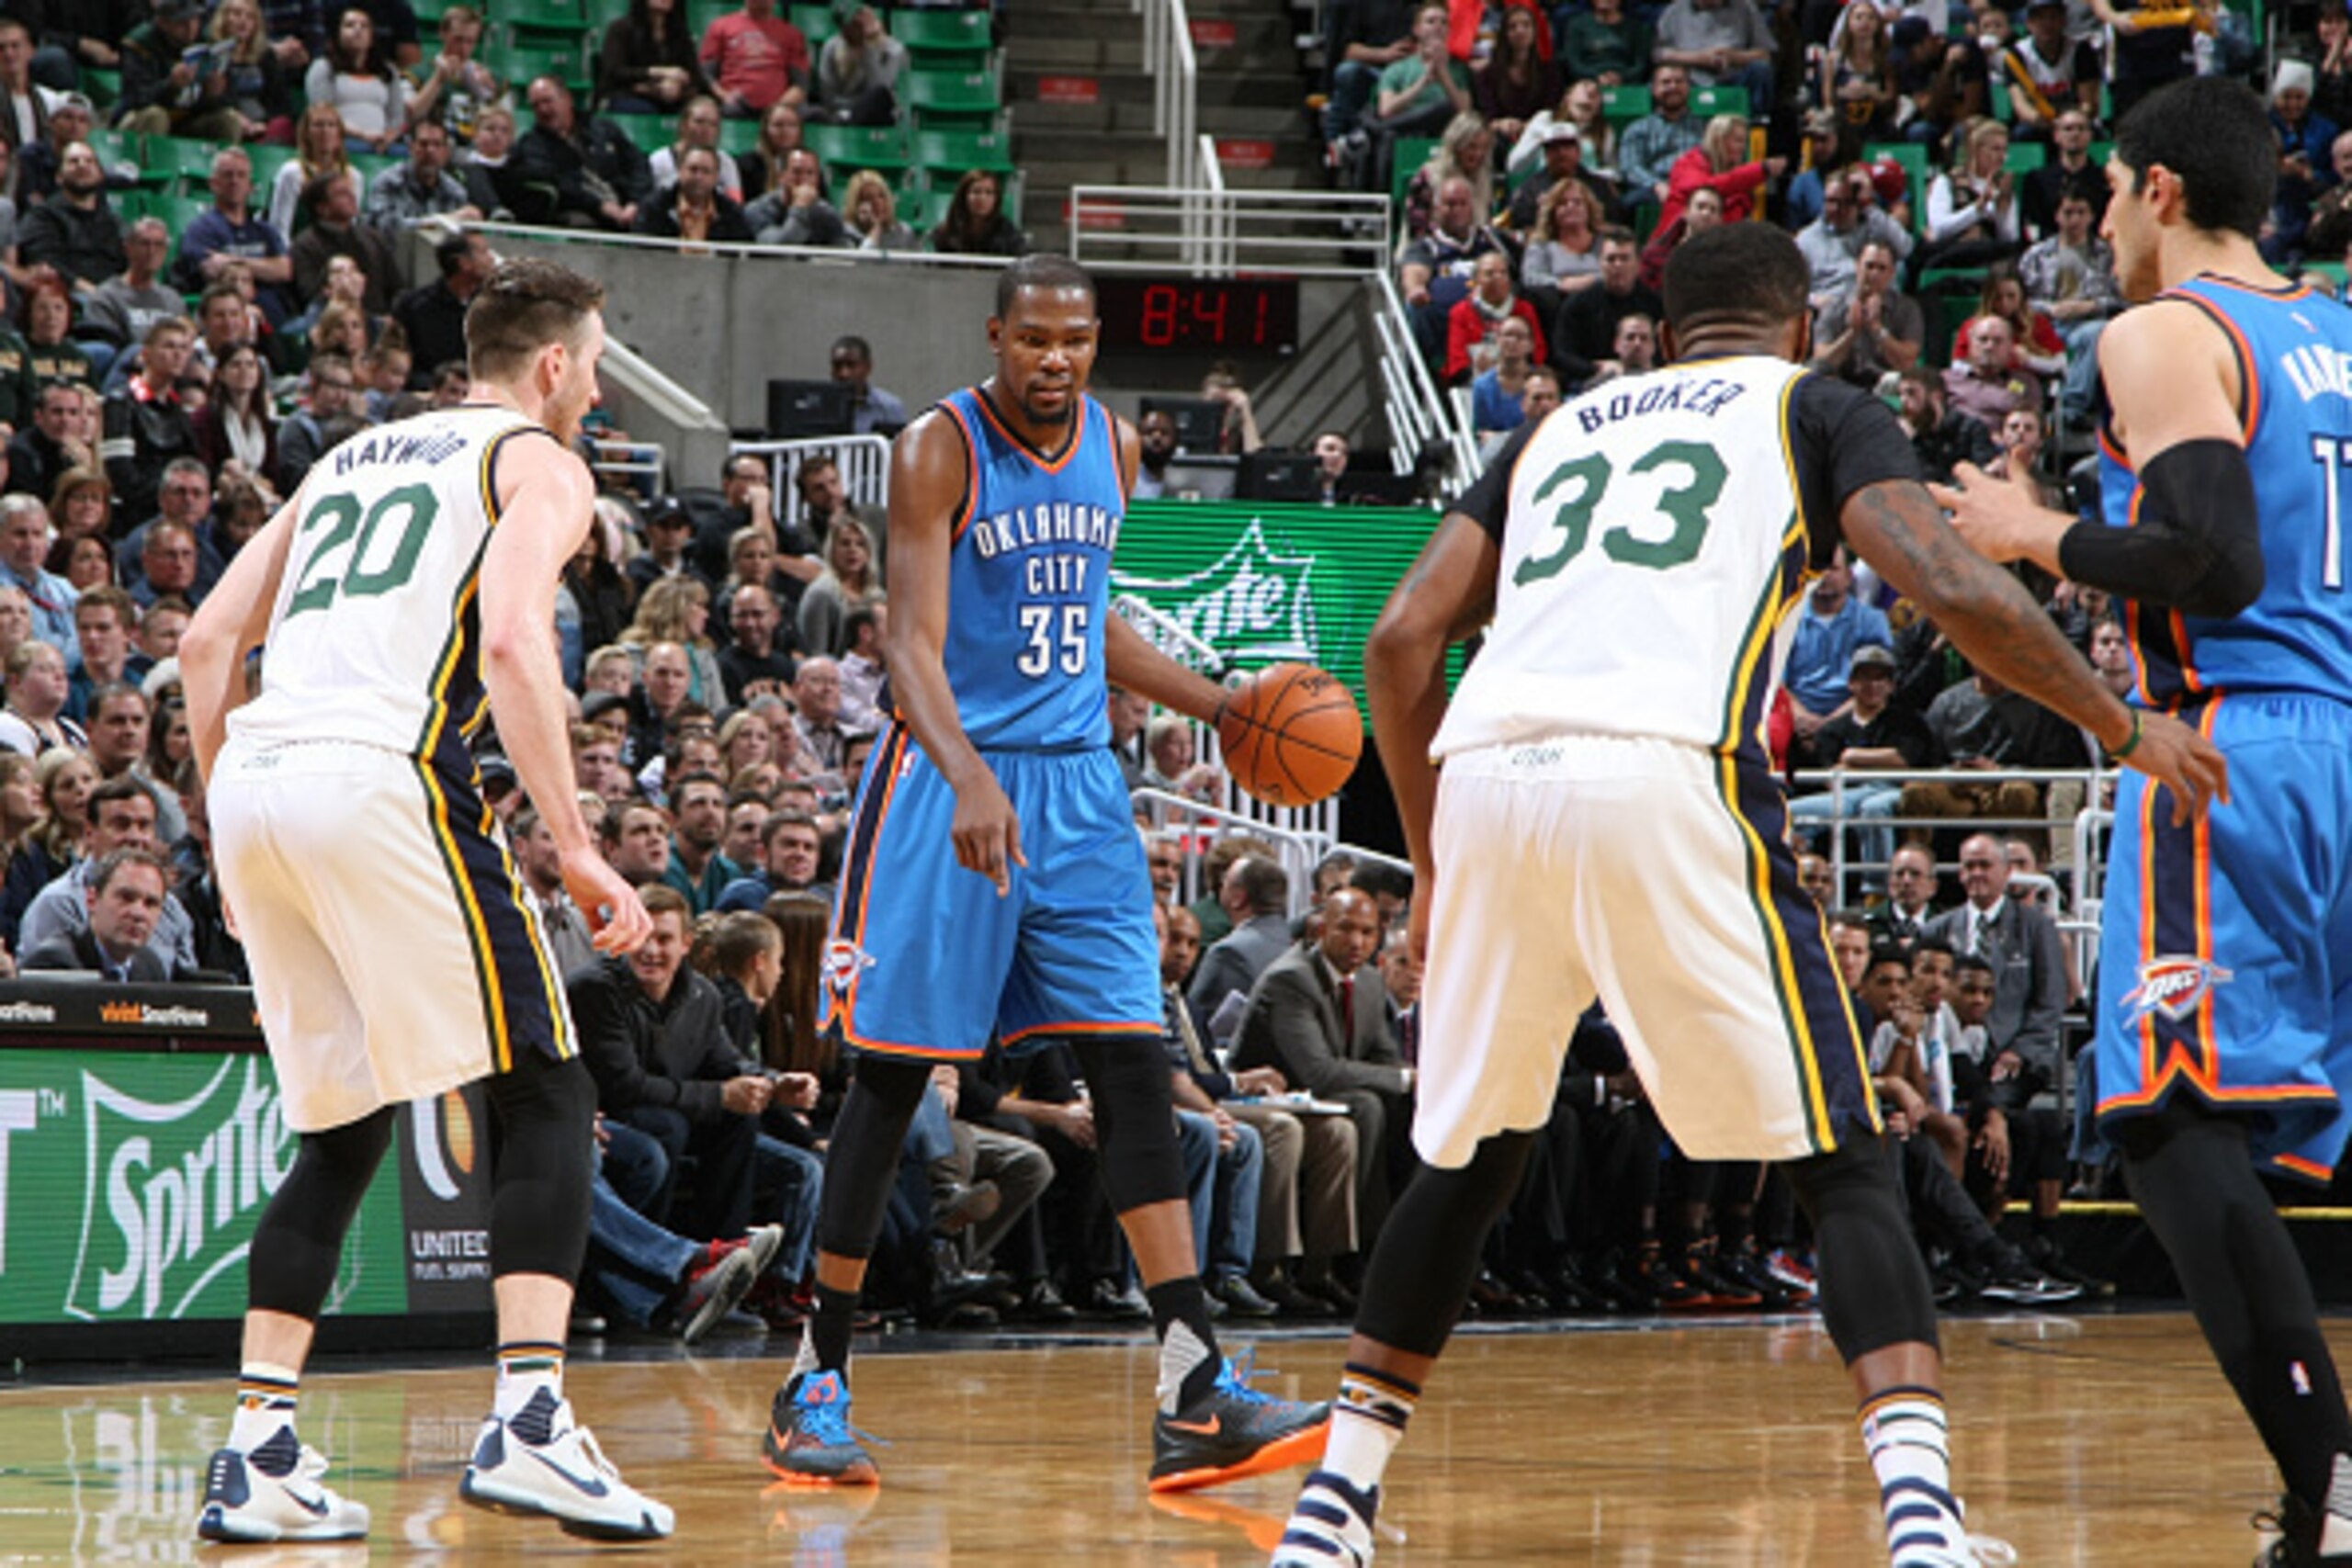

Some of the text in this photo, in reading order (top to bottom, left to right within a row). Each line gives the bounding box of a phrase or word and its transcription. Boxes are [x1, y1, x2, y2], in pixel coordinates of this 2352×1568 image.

[1140, 283, 1269, 346] 8:41
[1577, 378, 1747, 434] BOOKER
[1512, 439, 1729, 588] 33
[283, 481, 441, 621] 20
[1027, 554, 1090, 595] CITY
[1017, 604, 1090, 678] 35
[98, 1054, 300, 1320] Sprite
